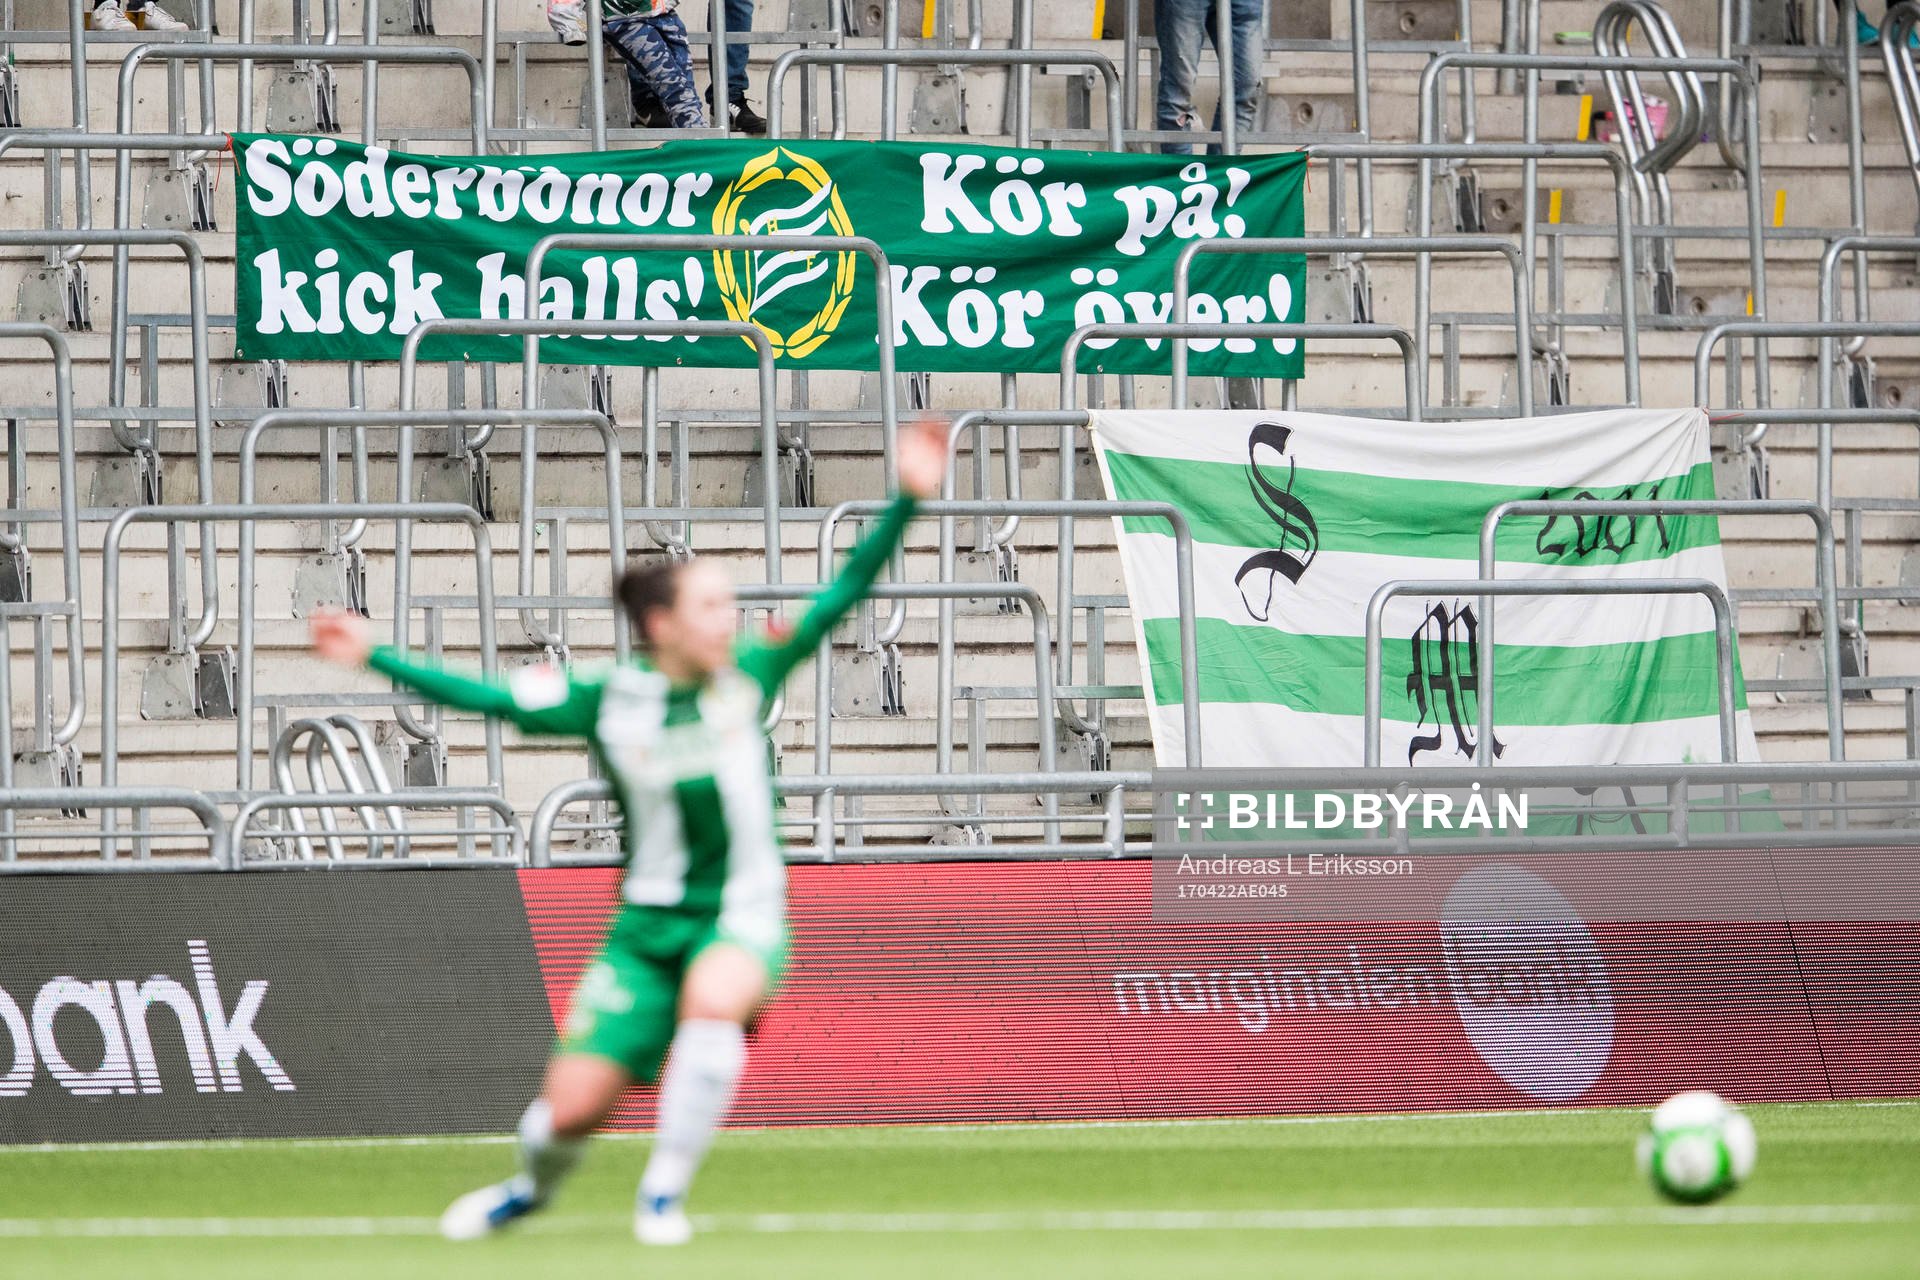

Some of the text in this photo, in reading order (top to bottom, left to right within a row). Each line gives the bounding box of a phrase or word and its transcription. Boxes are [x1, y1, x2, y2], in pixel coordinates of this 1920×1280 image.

[919, 152, 1251, 257] Kör på!
[253, 247, 706, 344] kick balls!
[875, 264, 1297, 356] Kör över!
[1113, 944, 1440, 1034] marginalen
